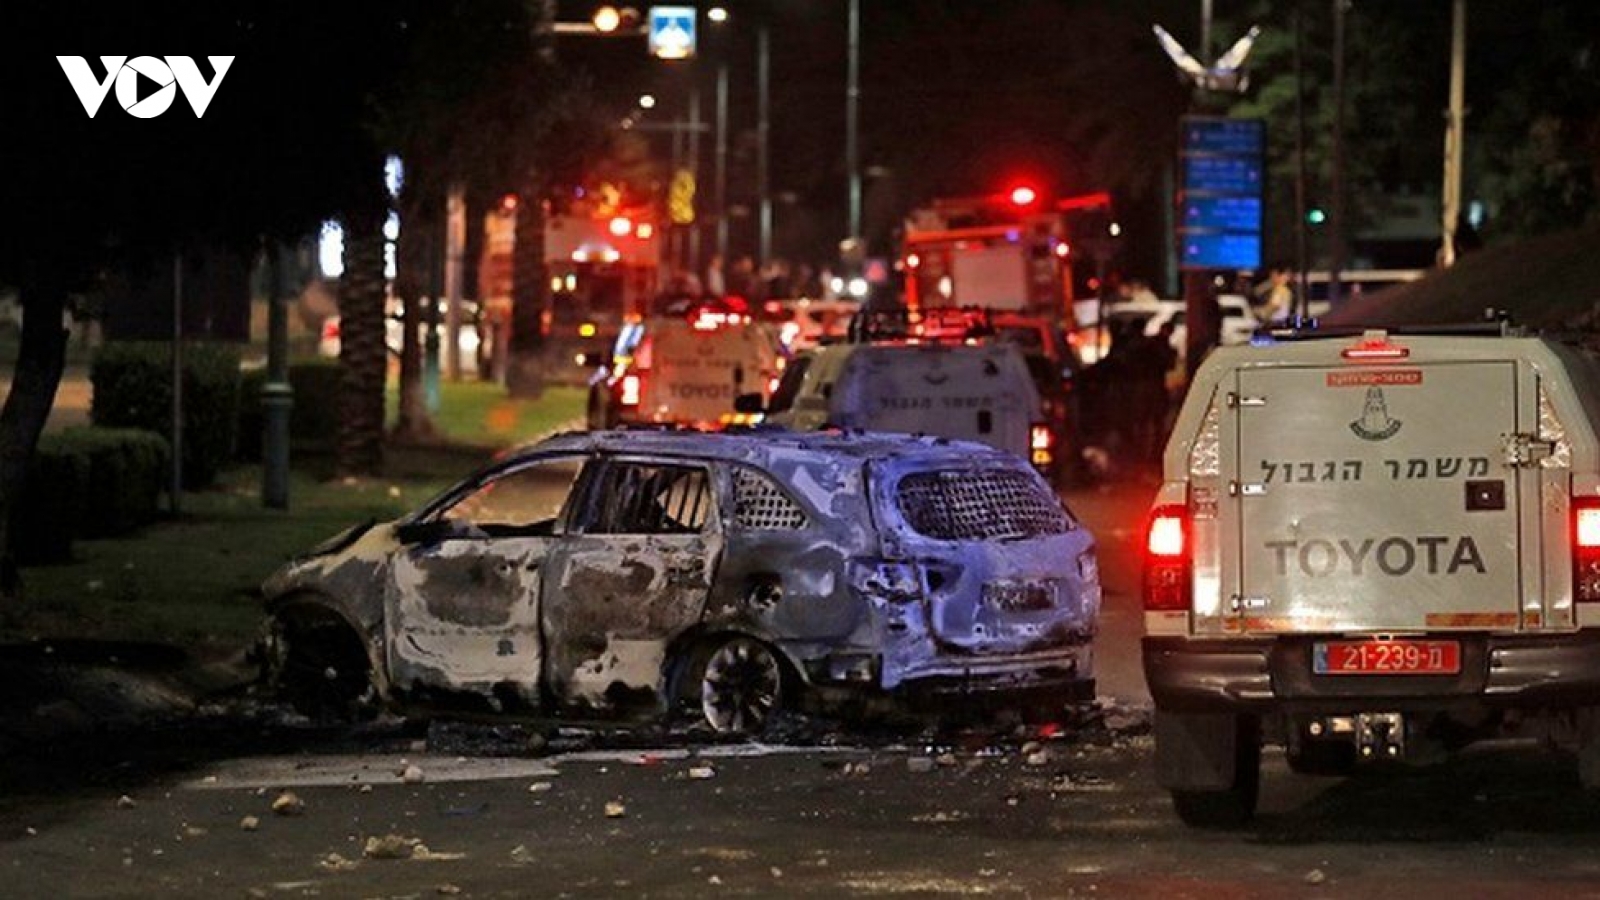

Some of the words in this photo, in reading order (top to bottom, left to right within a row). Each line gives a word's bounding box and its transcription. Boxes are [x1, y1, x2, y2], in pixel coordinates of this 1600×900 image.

[1261, 460, 1363, 483] הגבול
[1384, 457, 1489, 479] משמר
[1264, 536, 1487, 577] TOYOTA
